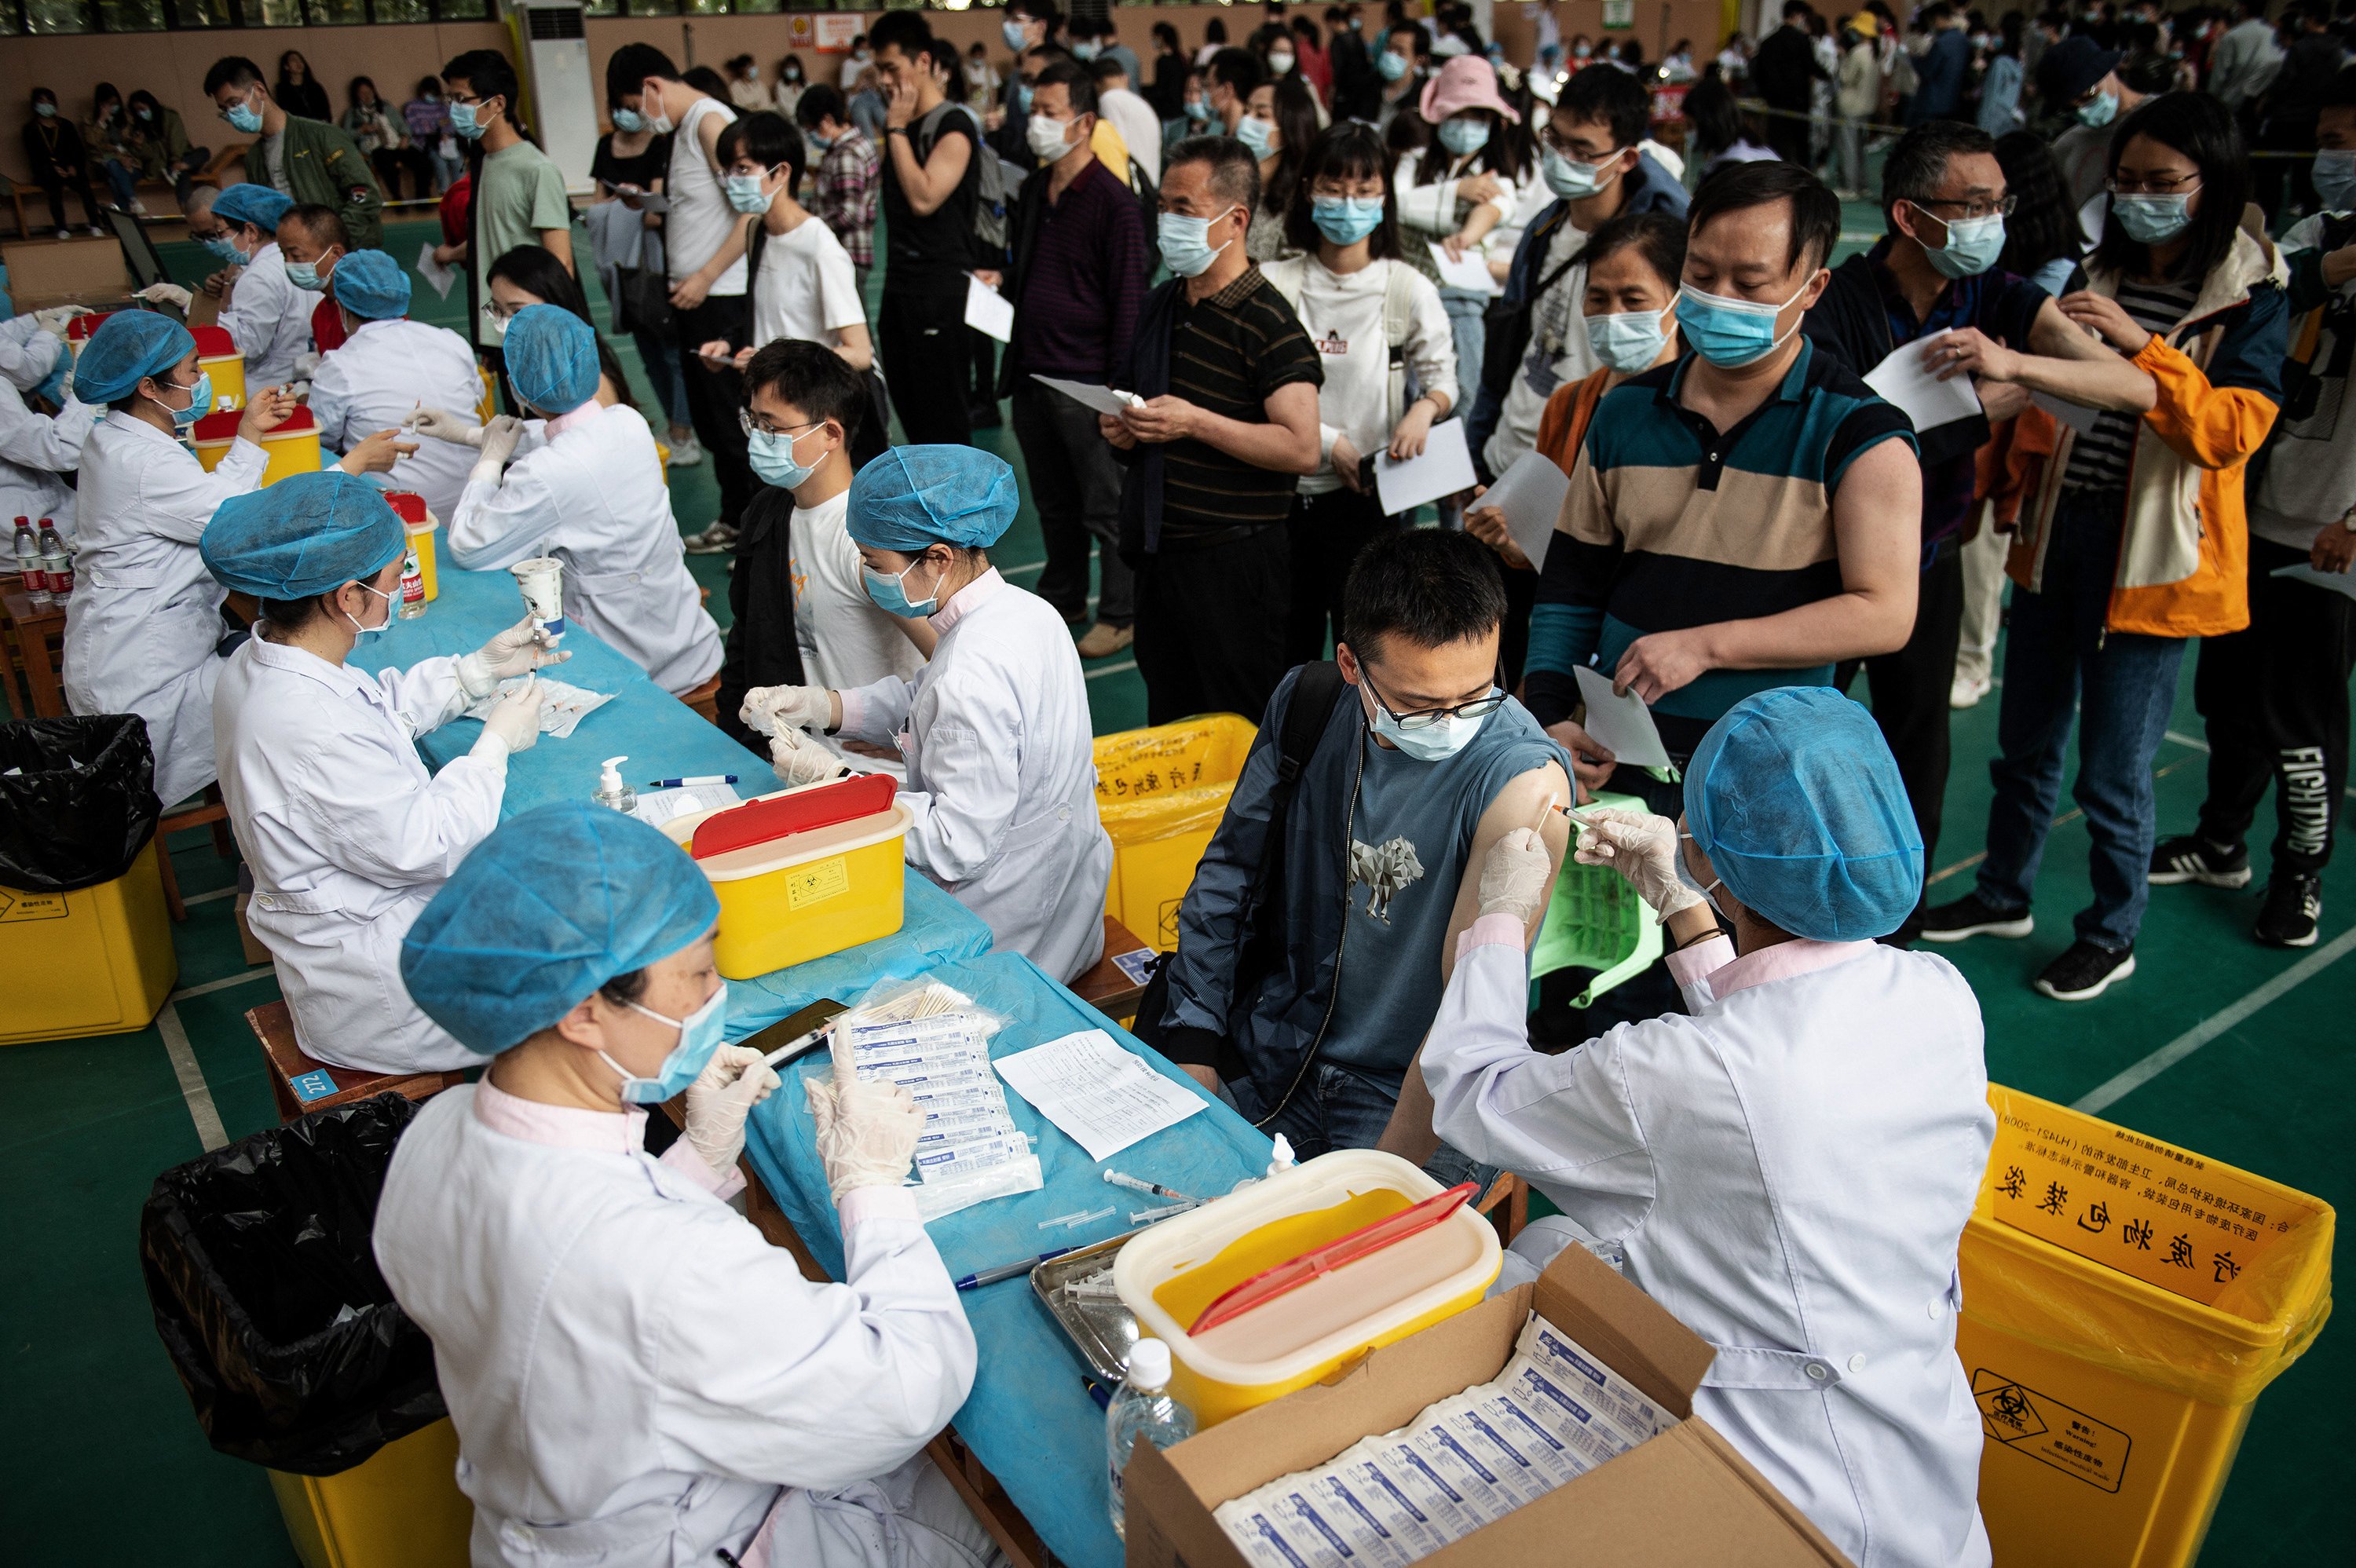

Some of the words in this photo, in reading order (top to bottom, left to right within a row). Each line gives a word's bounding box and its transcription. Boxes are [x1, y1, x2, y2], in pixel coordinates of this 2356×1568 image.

[2281, 747, 2329, 855] FIGHTING
[302, 1075, 327, 1094] 272
[2010, 1423, 2028, 1435] WASTE
[2065, 1429, 2097, 1449] Warning!
[2054, 1440, 2104, 1468] 感染性废物
[2069, 1459, 2093, 1475] medical
